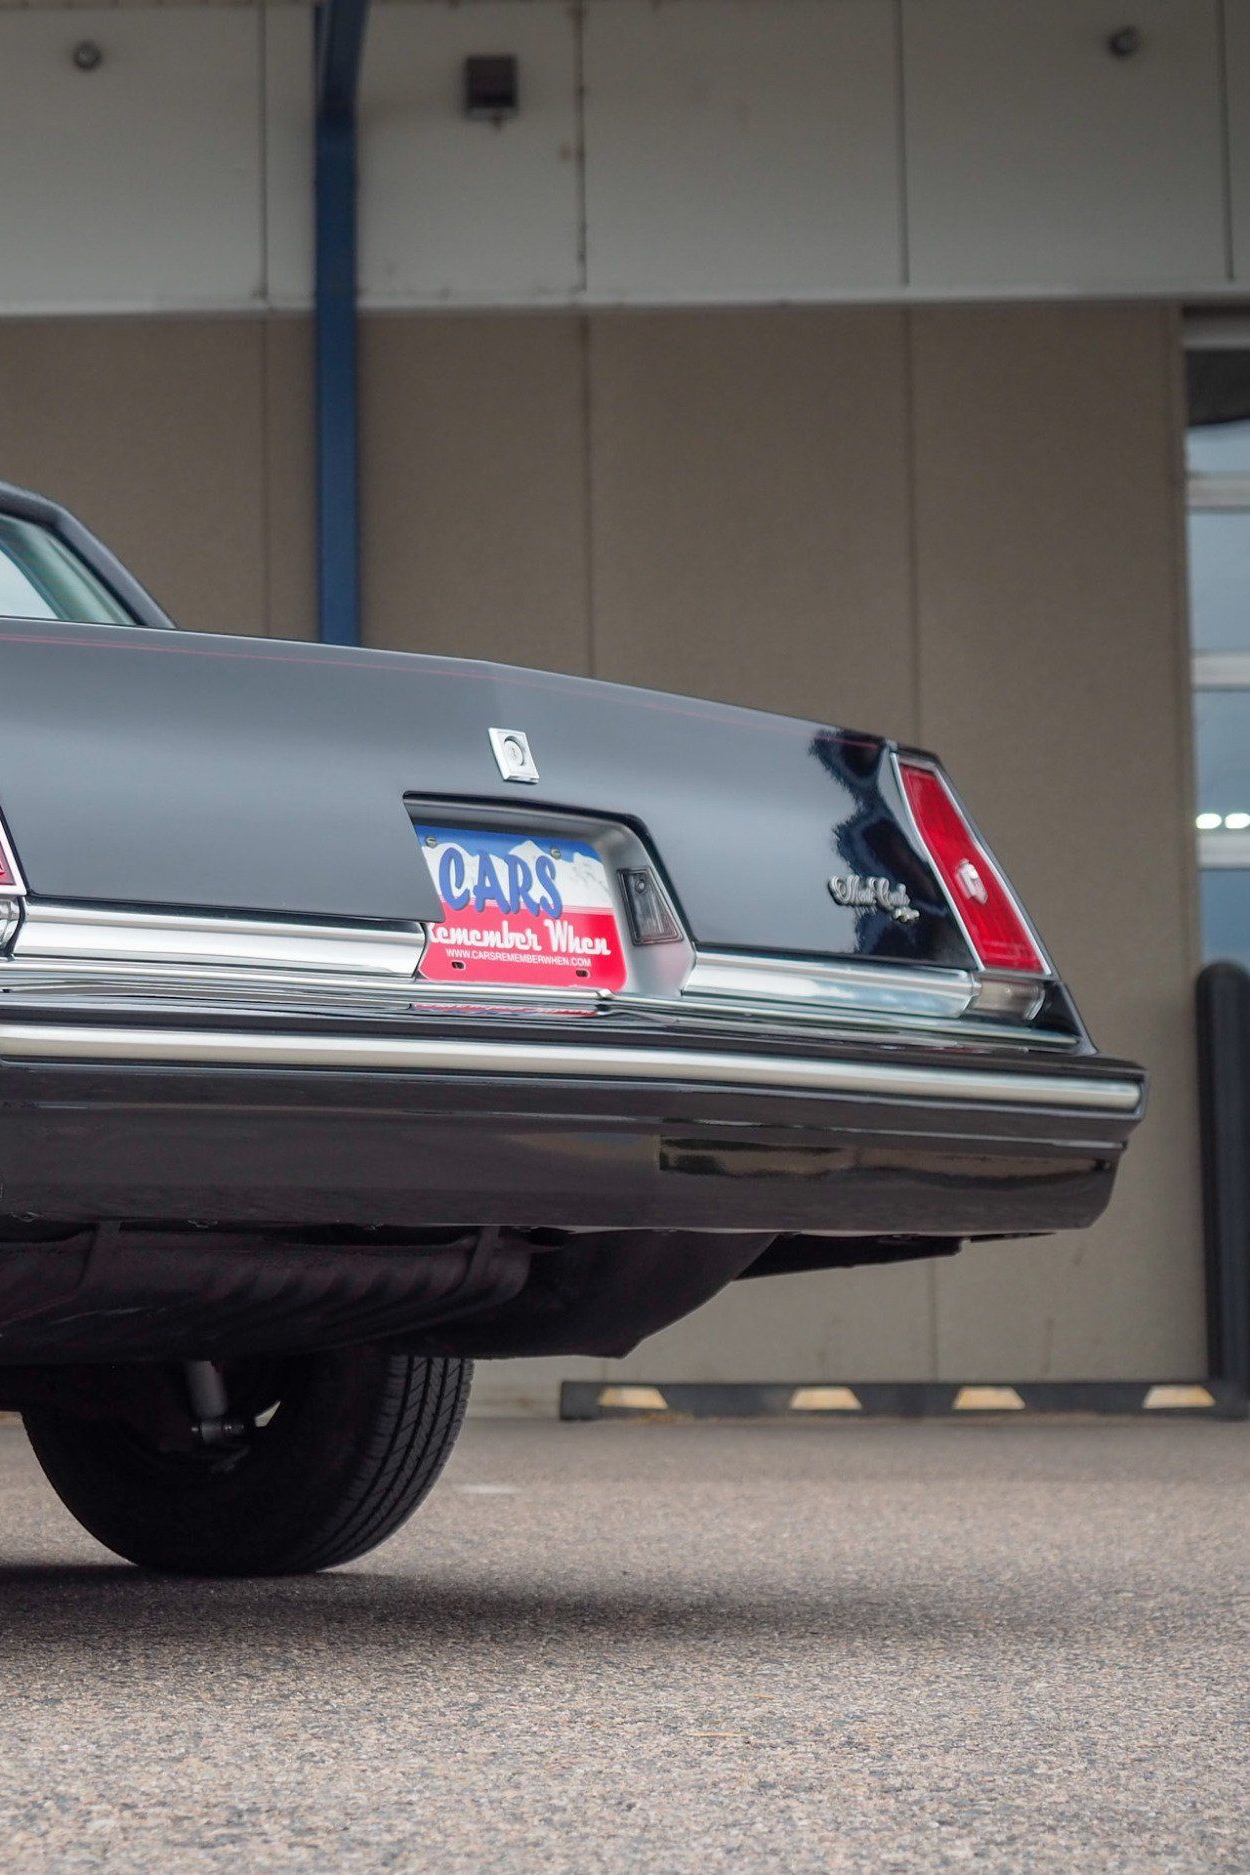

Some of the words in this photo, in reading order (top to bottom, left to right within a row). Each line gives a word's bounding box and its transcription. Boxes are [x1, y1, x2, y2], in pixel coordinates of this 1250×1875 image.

[439, 847, 564, 919] CARS
[544, 919, 611, 955] When
[445, 948, 592, 968] WWW.CARSREMEMBERWHEN.COM
